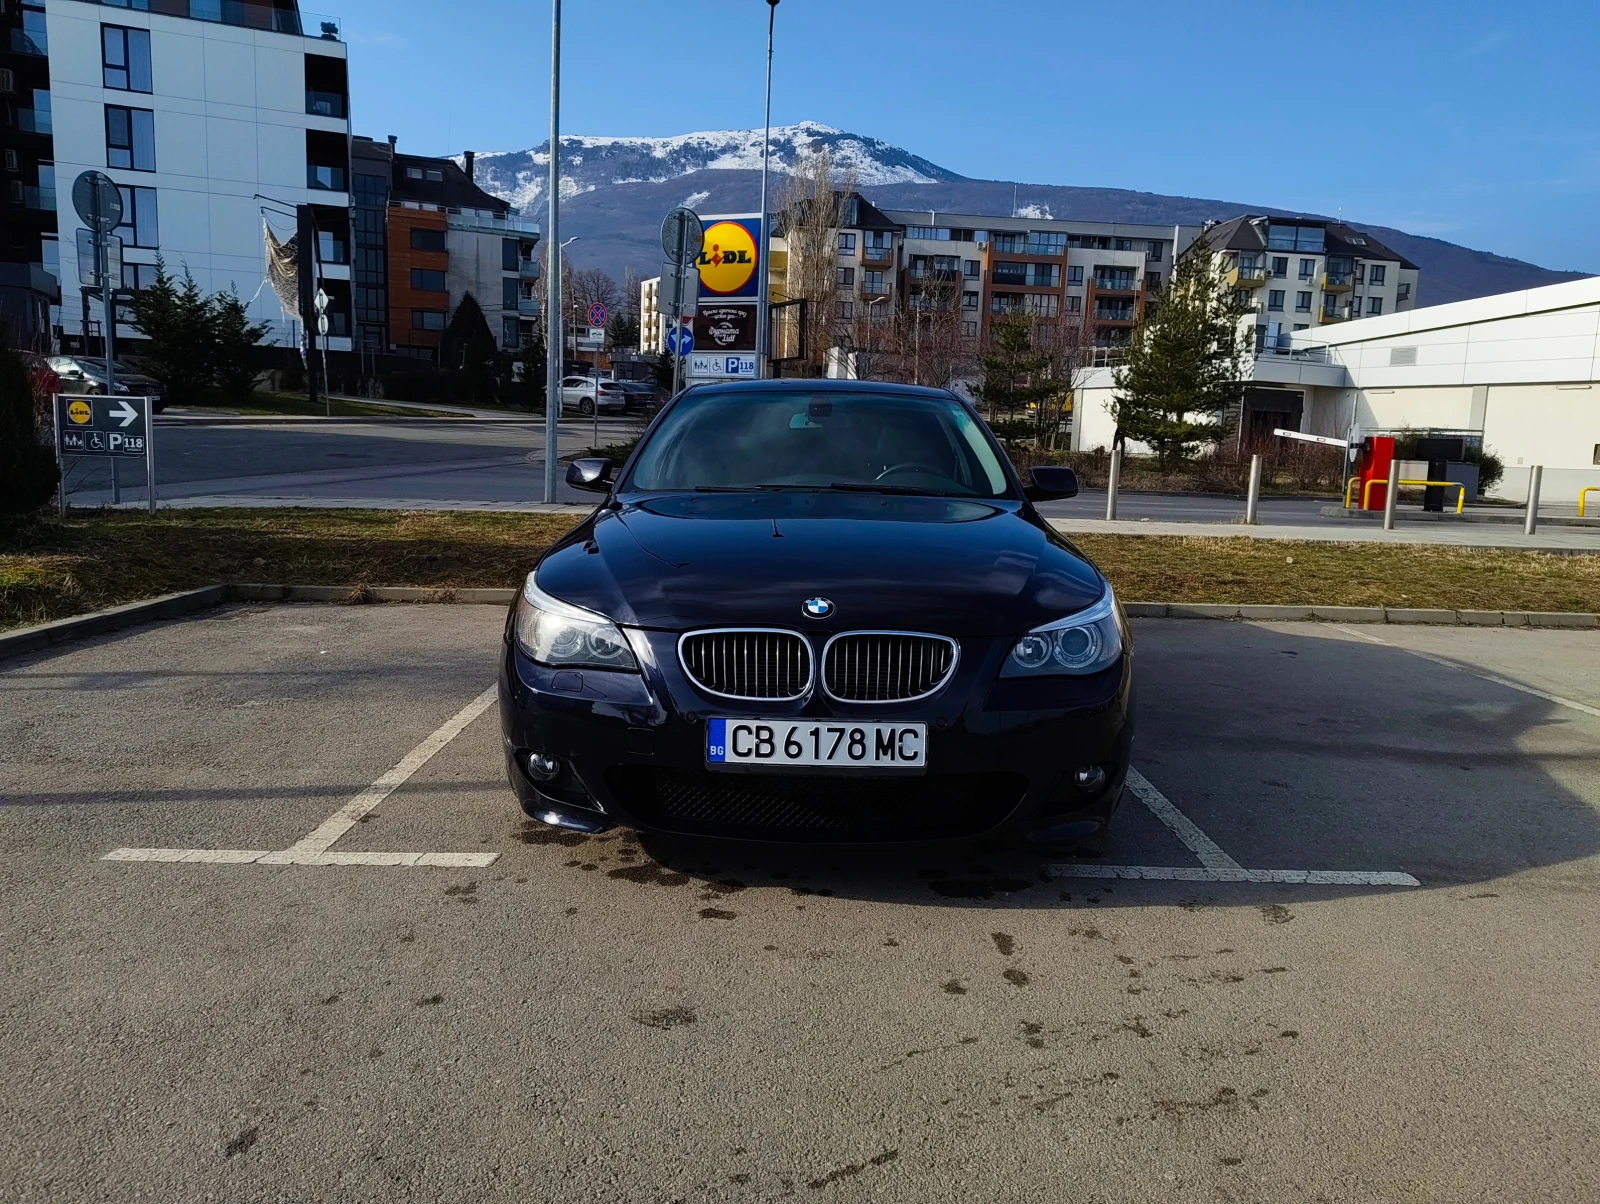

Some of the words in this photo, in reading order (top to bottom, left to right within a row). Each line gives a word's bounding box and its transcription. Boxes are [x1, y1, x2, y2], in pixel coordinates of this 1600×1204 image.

[728, 358, 738, 372] P
[740, 361, 754, 370] 118
[109, 433, 122, 450] P
[124, 438, 143, 448] 118
[710, 745, 724, 756] BG
[731, 724, 775, 759] CB
[783, 726, 866, 761] 6178
[874, 728, 919, 762] MC
